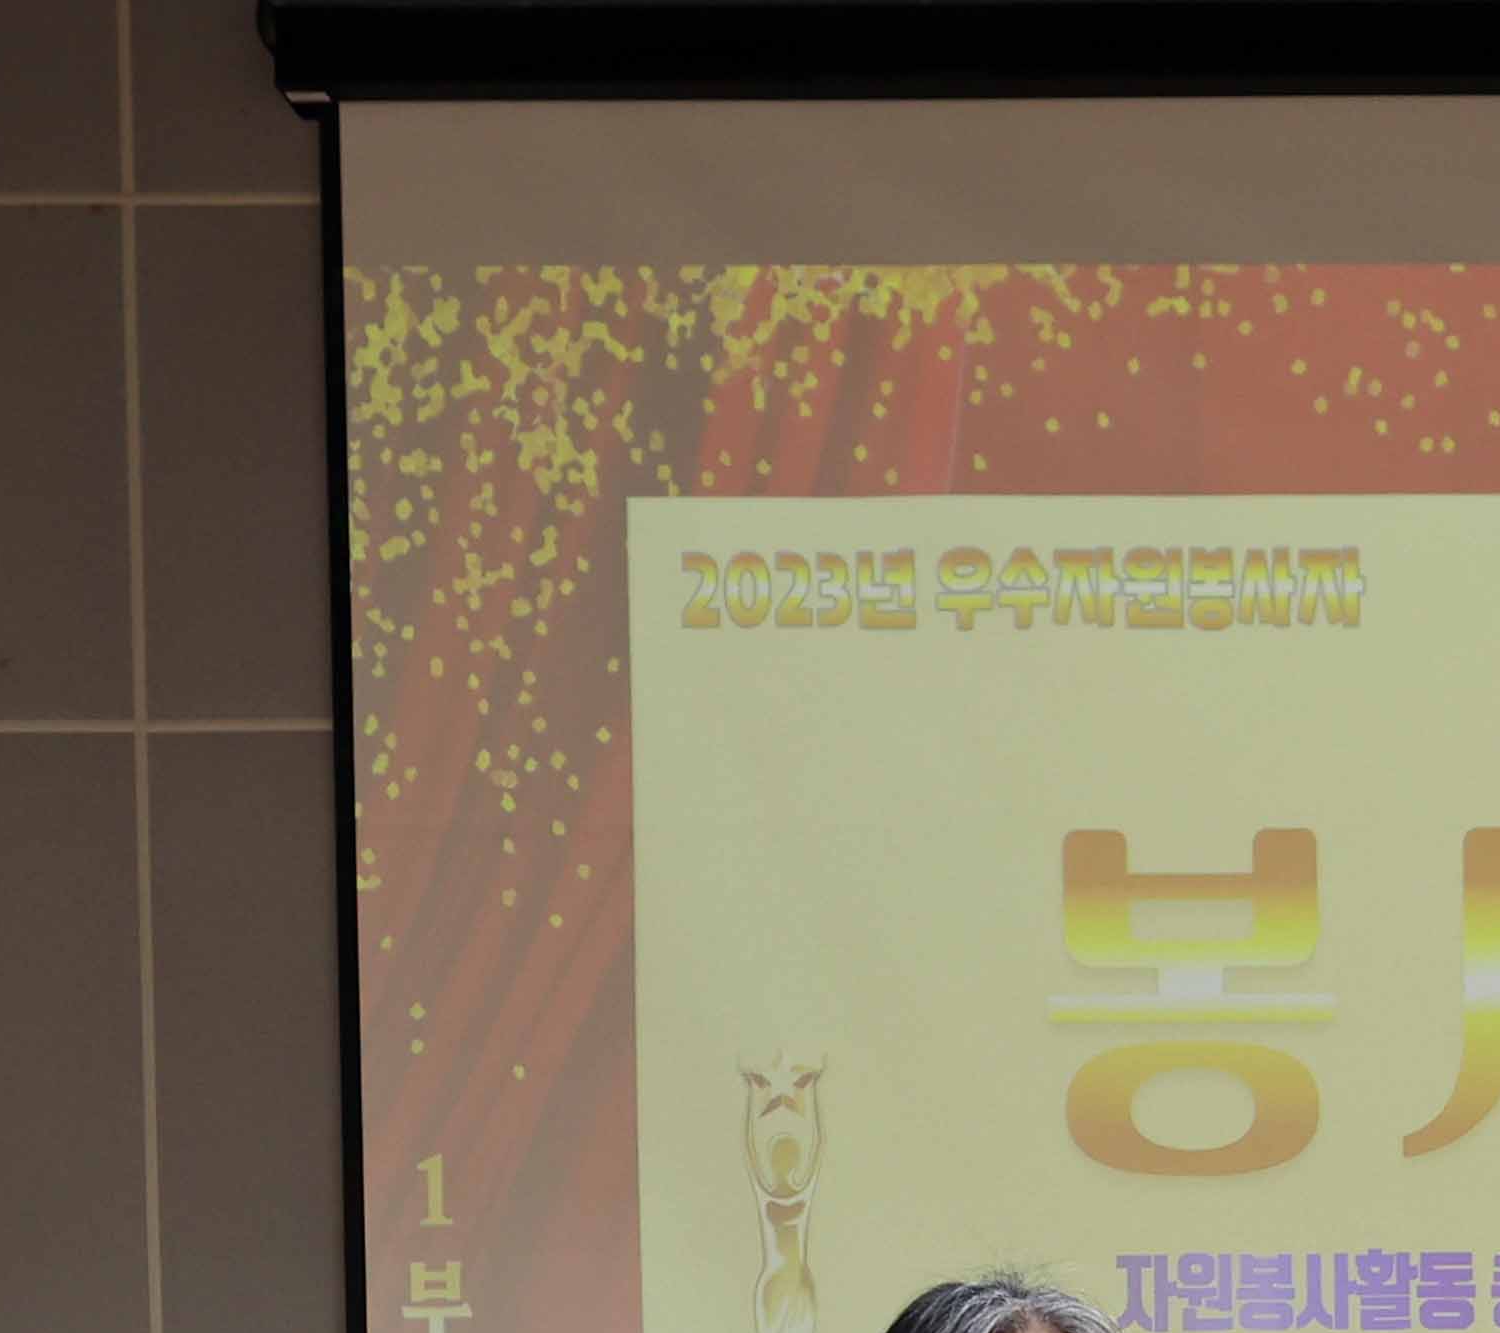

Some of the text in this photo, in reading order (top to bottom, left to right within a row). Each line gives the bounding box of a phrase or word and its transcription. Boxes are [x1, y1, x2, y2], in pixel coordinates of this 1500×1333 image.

[680, 544, 1366, 632] 2023년 우수자원봉사자
[1114, 1248, 1477, 1333] 자원봉사활동
